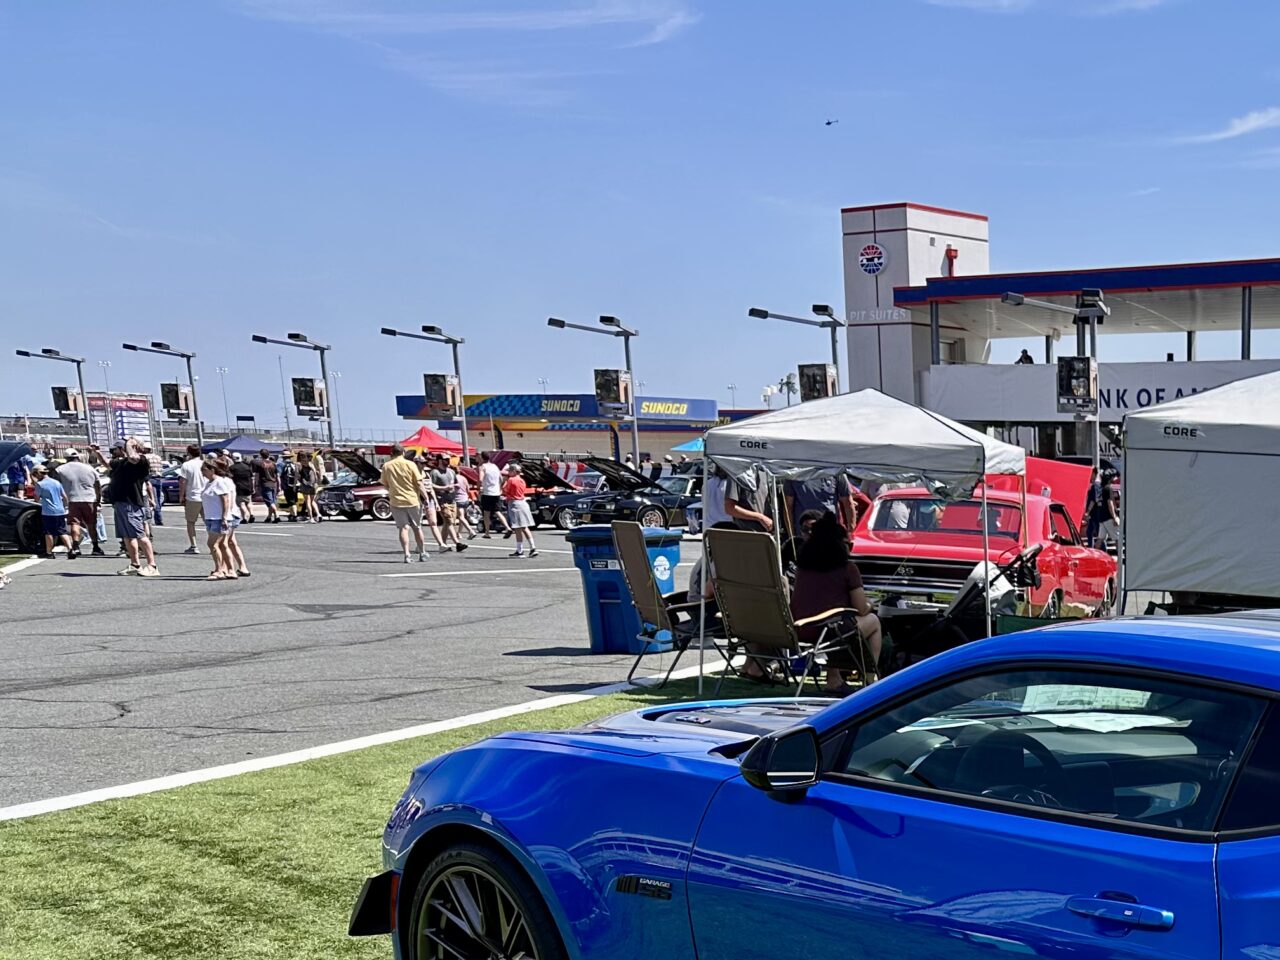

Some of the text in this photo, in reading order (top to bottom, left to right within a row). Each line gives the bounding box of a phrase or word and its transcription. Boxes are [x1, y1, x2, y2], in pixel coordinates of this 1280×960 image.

[850, 309, 906, 321] PIT SUITES
[541, 400, 580, 411] SUNOCO
[641, 402, 688, 414] SUNOCO
[1163, 426, 1198, 437] CORE
[740, 441, 768, 449] CORE
